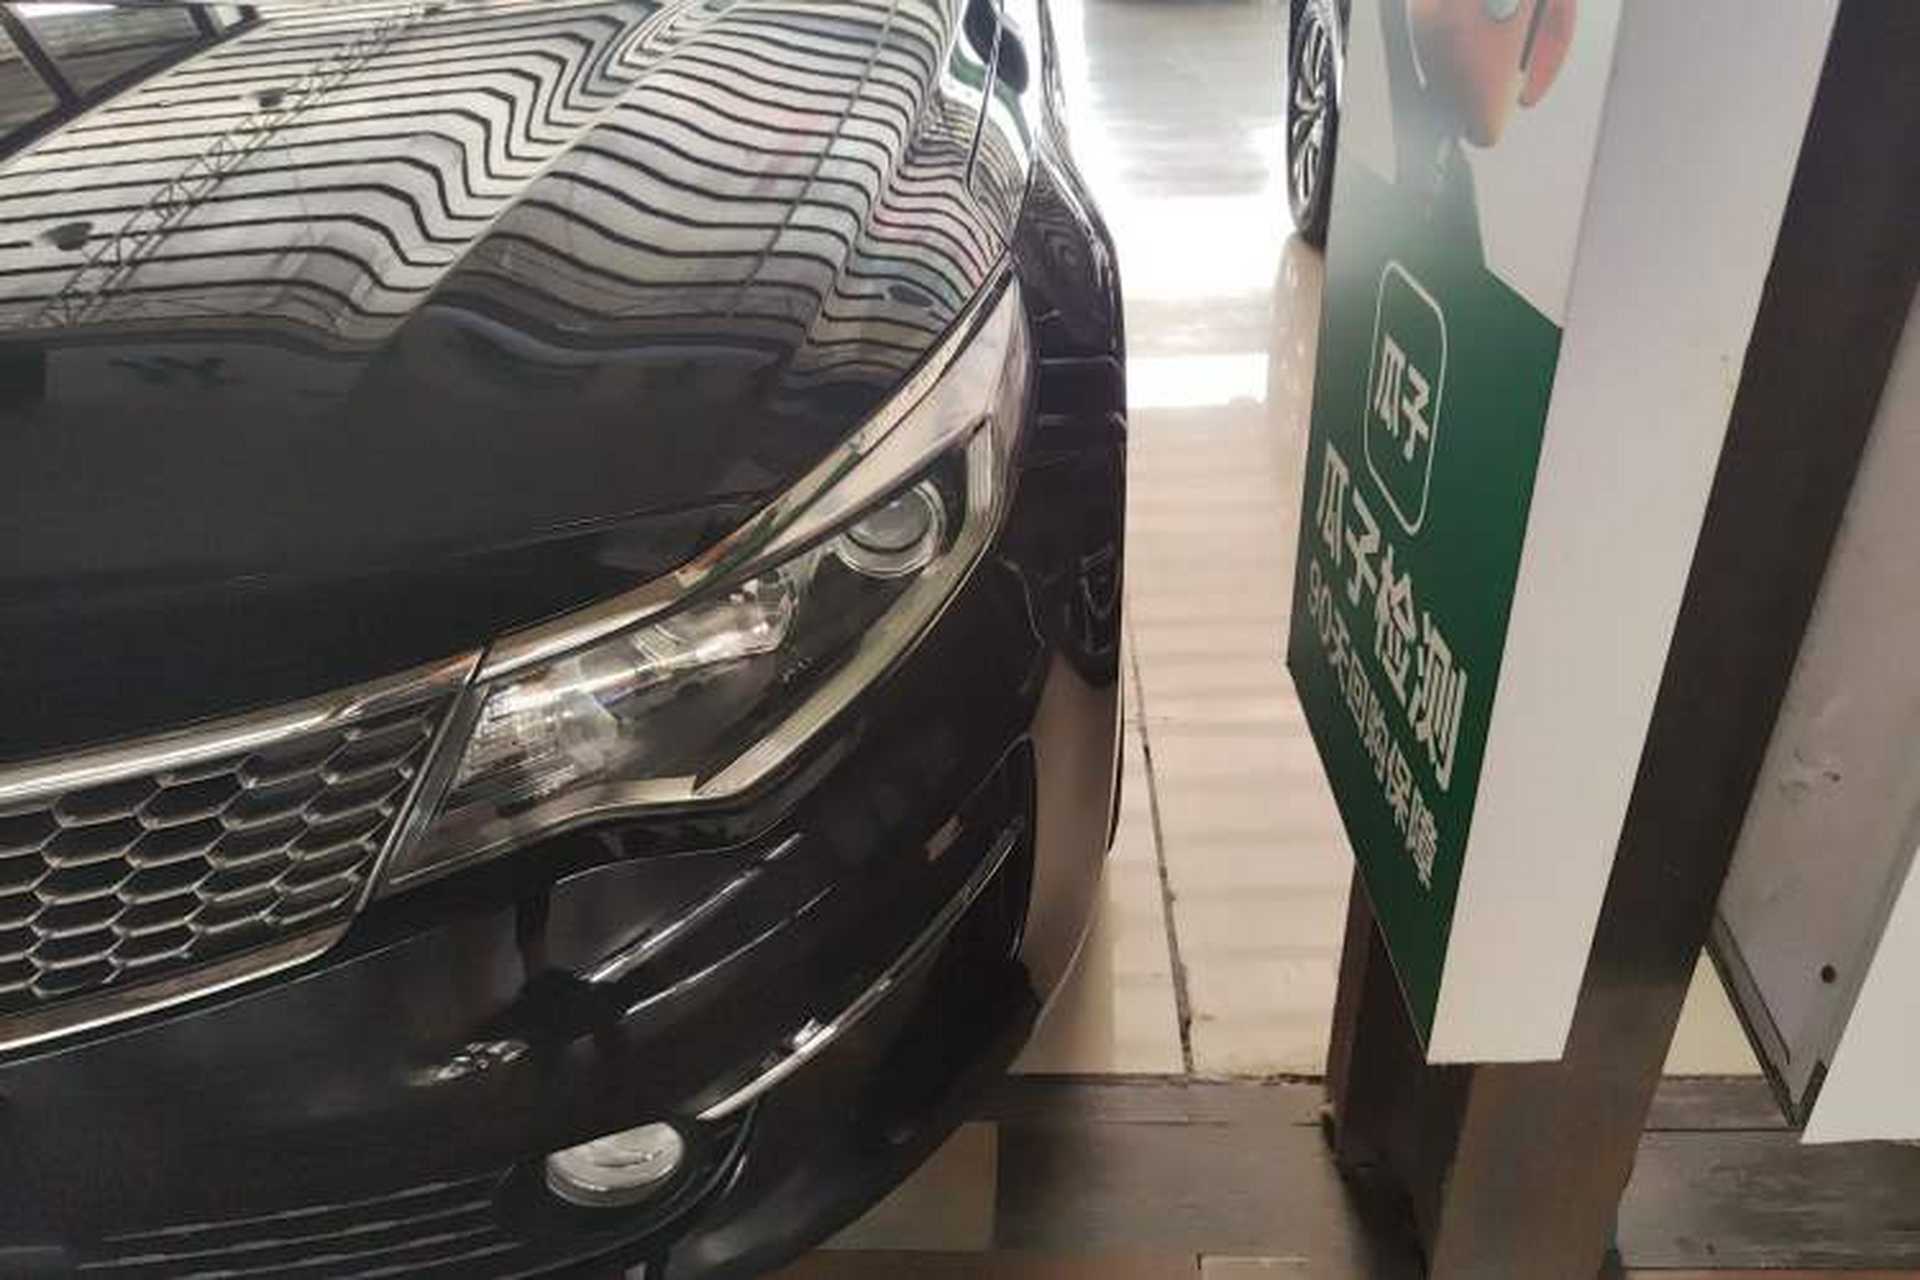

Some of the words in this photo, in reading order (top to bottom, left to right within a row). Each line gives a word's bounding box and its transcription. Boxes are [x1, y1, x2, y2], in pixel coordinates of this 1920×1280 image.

[1374, 334, 1430, 461] 瓜子
[1308, 559, 1438, 891] 90天回购保障
[1316, 440, 1468, 792] 瓜子检测
